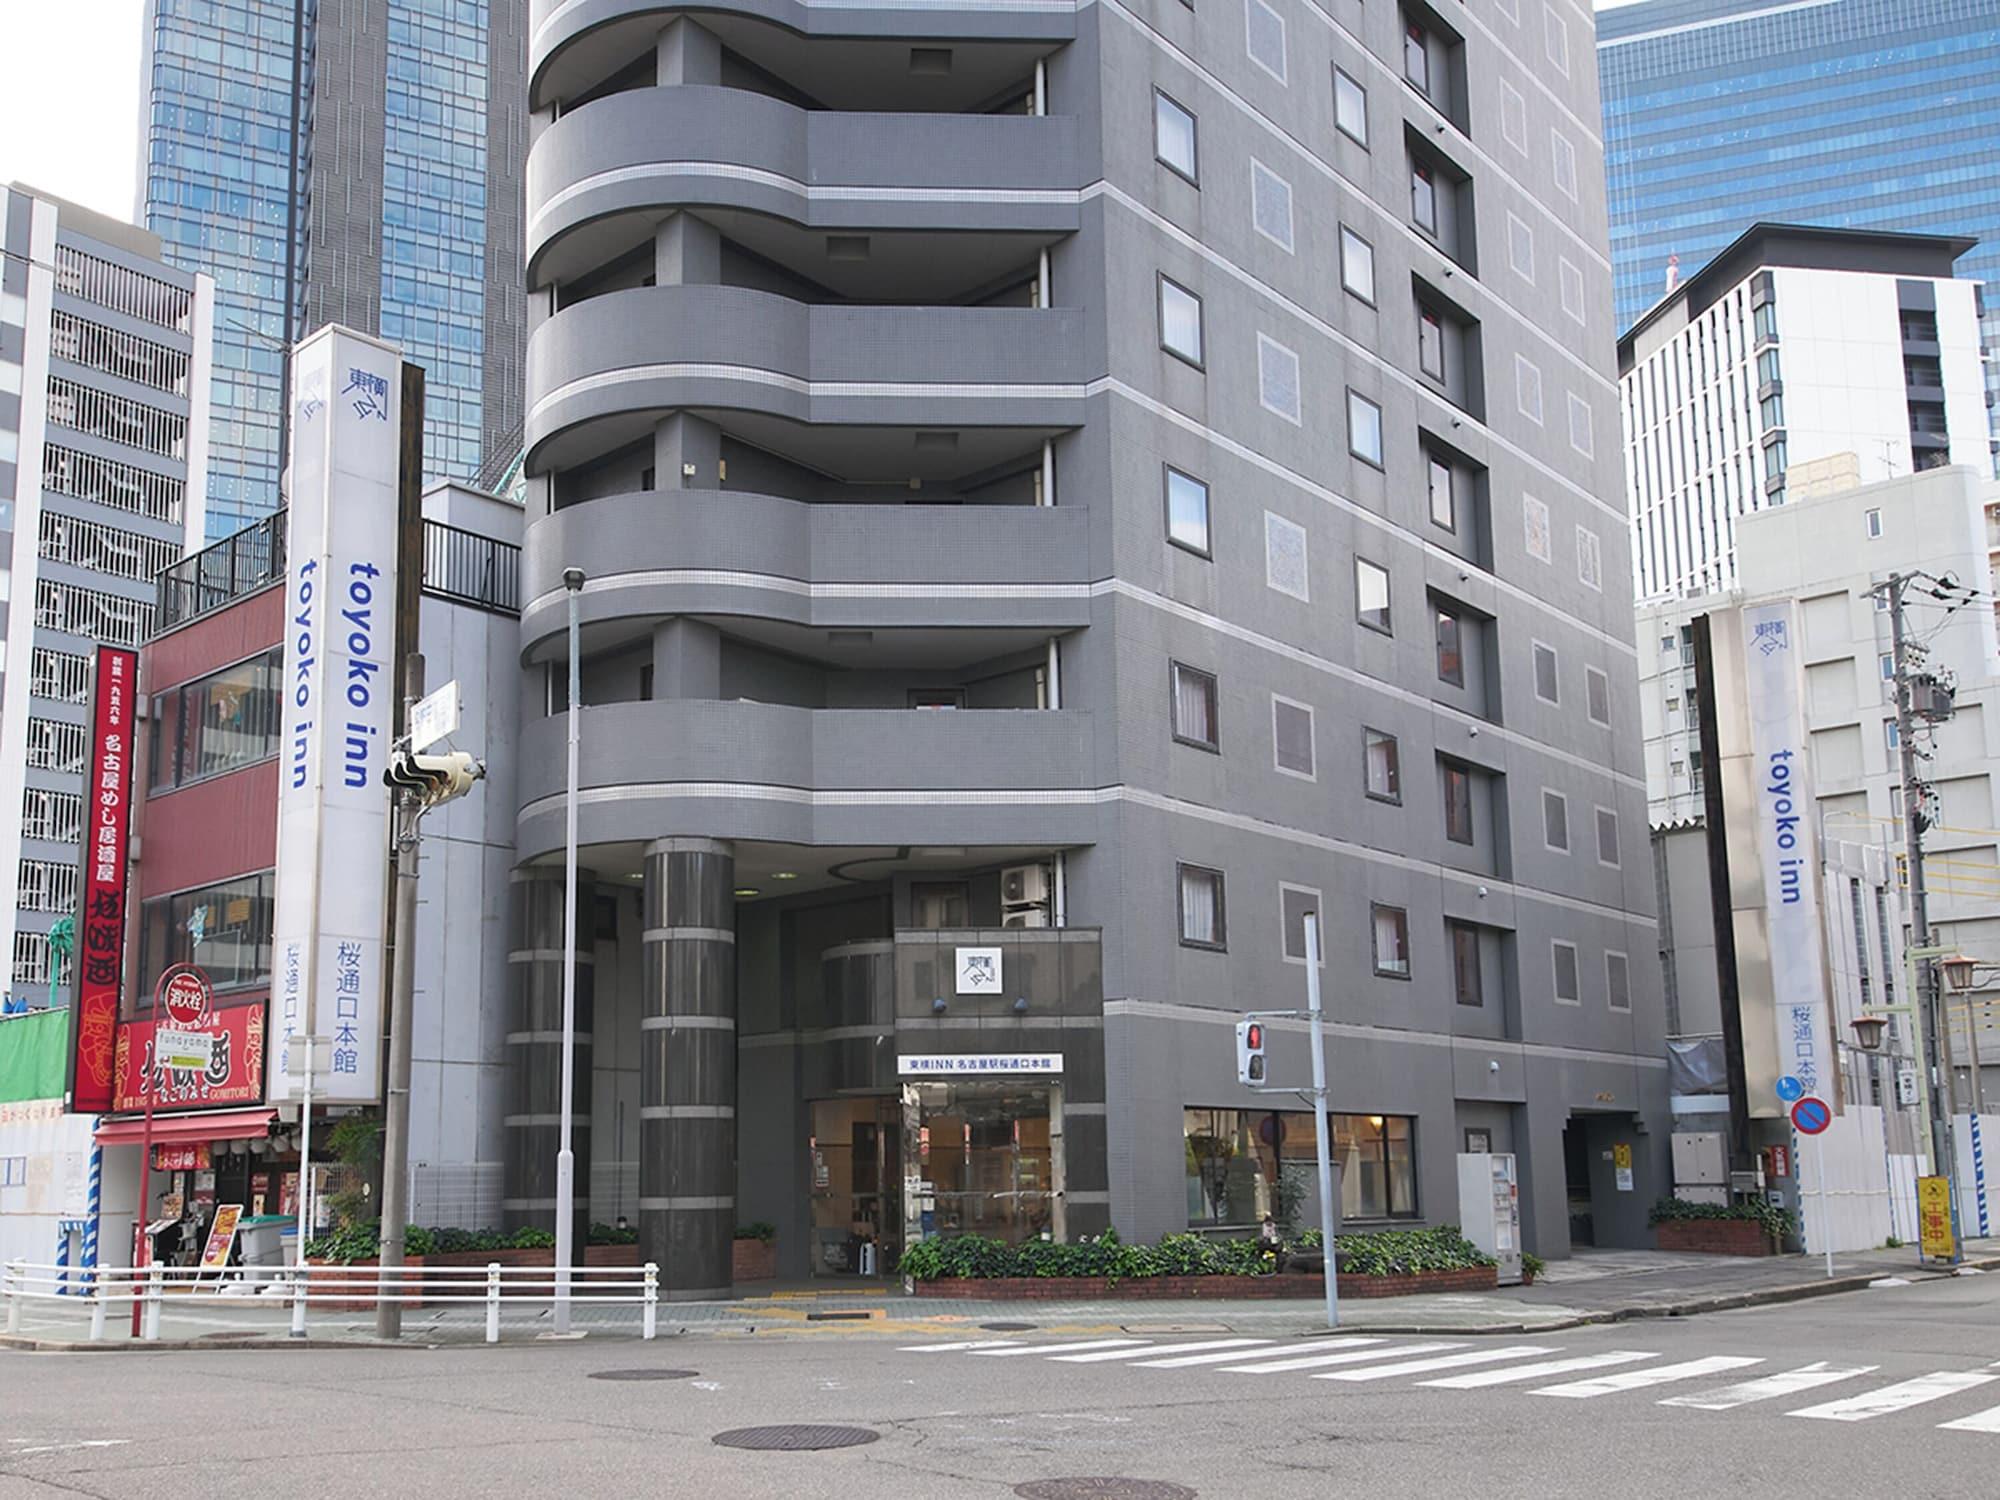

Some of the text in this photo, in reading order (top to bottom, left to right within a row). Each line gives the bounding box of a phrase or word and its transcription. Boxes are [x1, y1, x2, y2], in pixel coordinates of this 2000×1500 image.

[292, 558, 318, 789] toyoko inn
[341, 562, 380, 789] toyoko inn
[96, 733, 122, 884] 名古屋めし居酒屋
[1767, 750, 1804, 904] toyoko inn
[169, 987, 202, 1010] 消火栓
[333, 941, 361, 1074] 桜通口本館
[1928, 1202, 1945, 1242] 工事中
